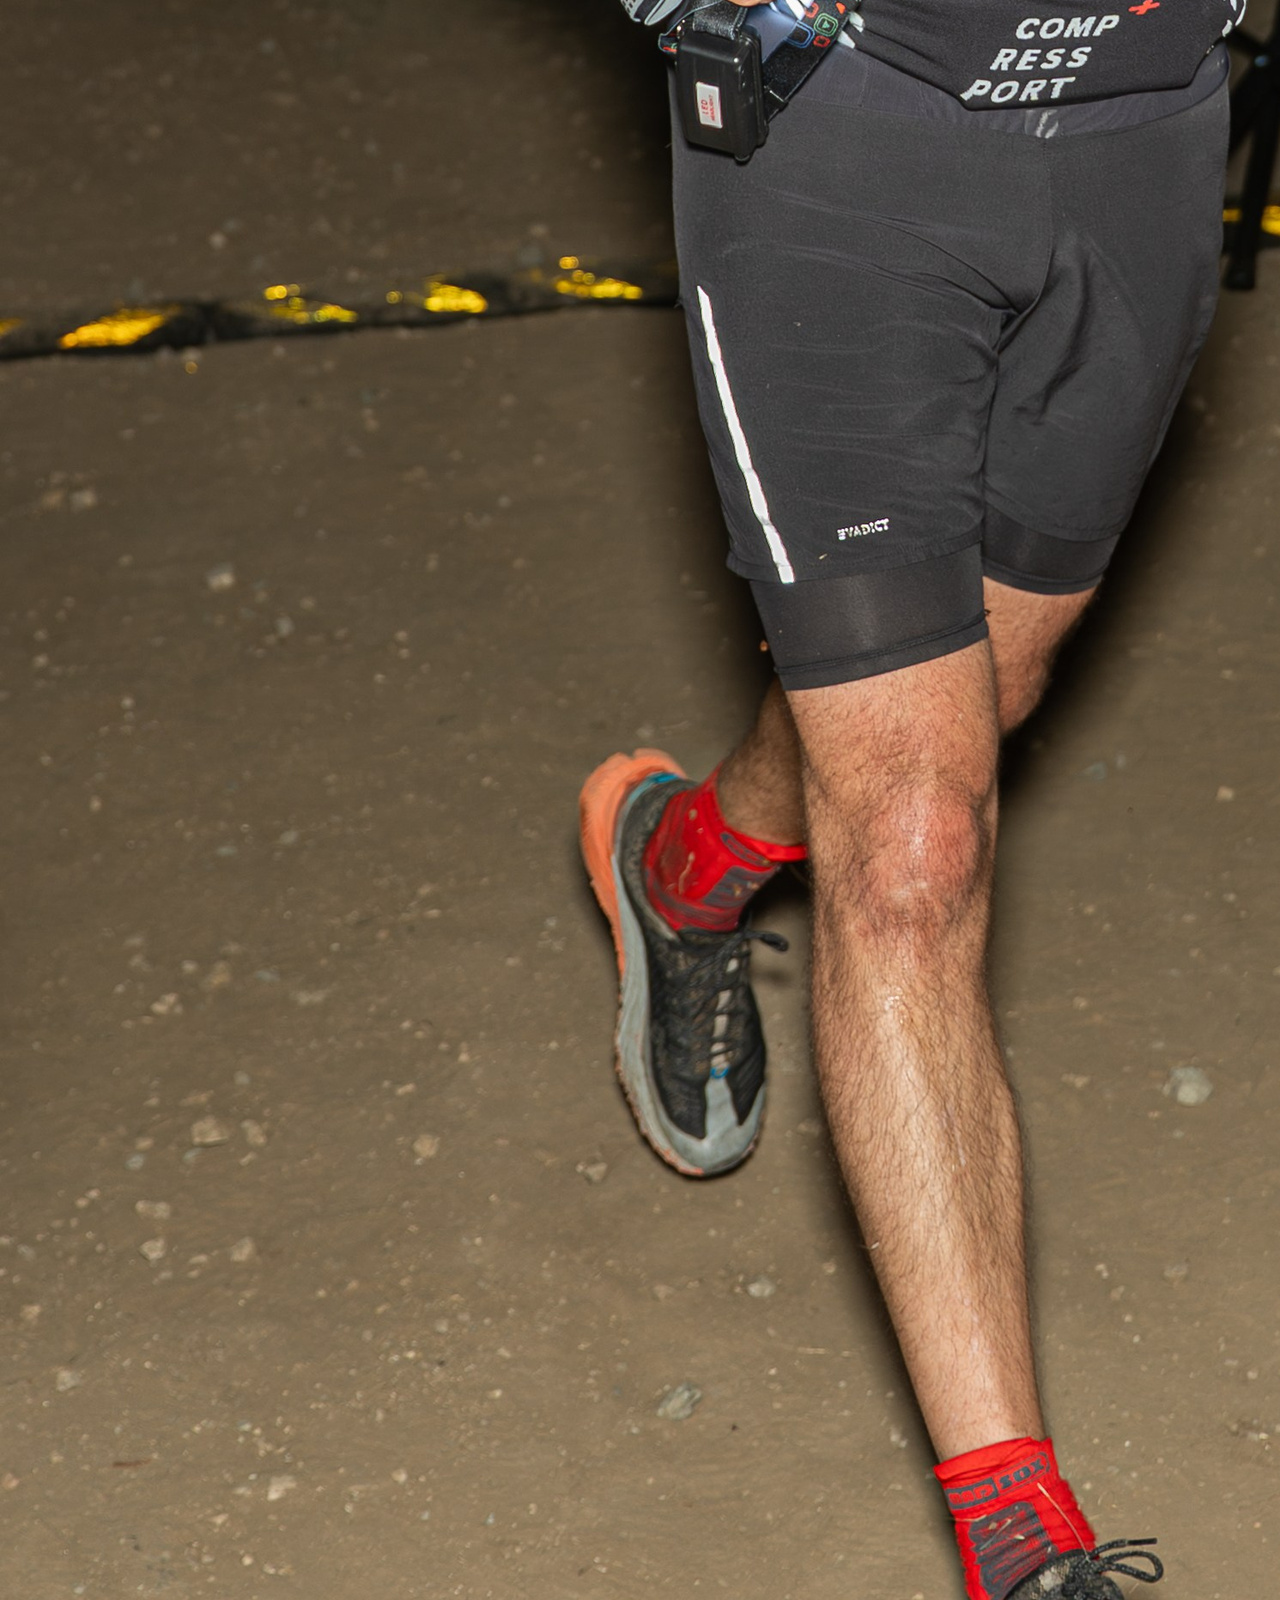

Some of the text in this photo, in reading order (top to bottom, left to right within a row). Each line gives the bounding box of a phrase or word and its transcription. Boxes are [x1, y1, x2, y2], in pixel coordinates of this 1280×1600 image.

[1015, 14, 1120, 40] COMP
[990, 46, 1093, 71] RESS
[961, 76, 1076, 103] PORT
[701, 99, 709, 115] LED
[837, 518, 889, 540] EVADICT
[999, 1458, 1045, 1489] SOX
